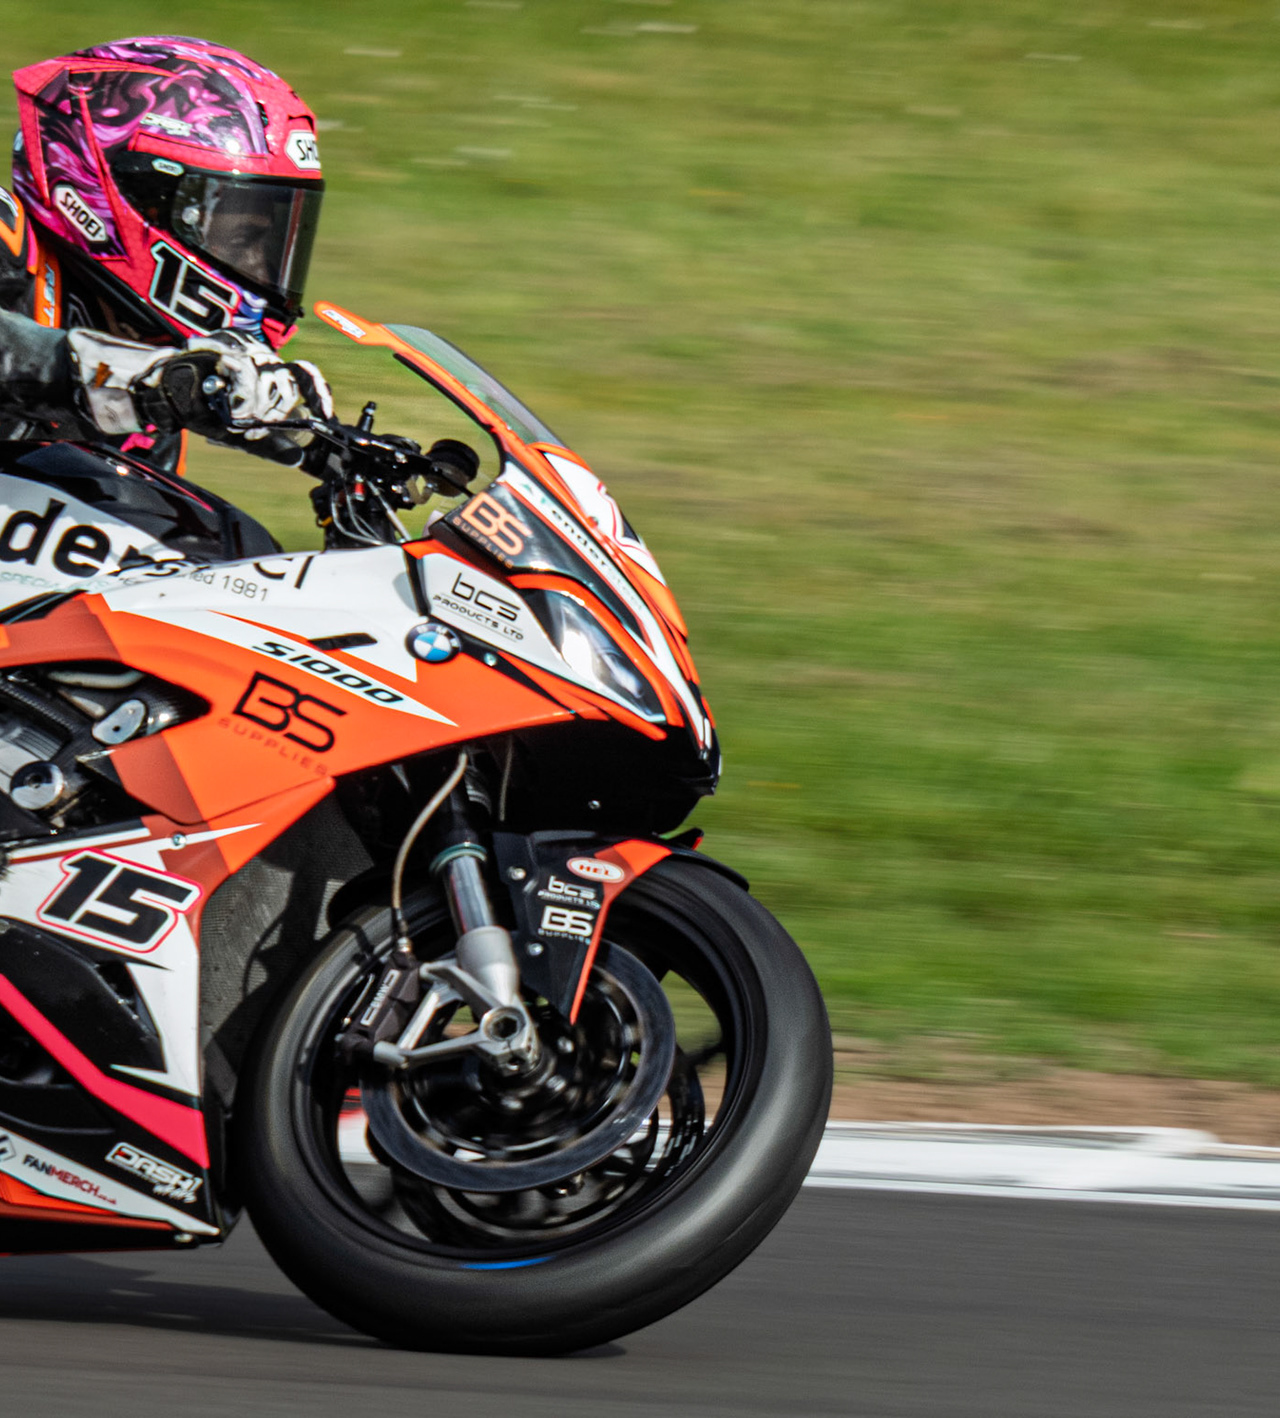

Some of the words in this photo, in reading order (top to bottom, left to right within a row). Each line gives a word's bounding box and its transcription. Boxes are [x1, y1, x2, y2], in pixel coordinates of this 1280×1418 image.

[58, 191, 104, 240] SHOEI
[150, 241, 241, 337] 15
[452, 516, 515, 570] SUPPLIES
[460, 491, 533, 556] BS
[222, 574, 269, 602] 1981
[432, 594, 500, 629] PRODUCTS
[502, 626, 525, 641] LTD
[251, 641, 404, 705] S1000
[233, 671, 347, 753] BS
[217, 717, 329, 774] SUPPLIES
[42, 854, 194, 945] 15
[541, 905, 595, 938] BS
